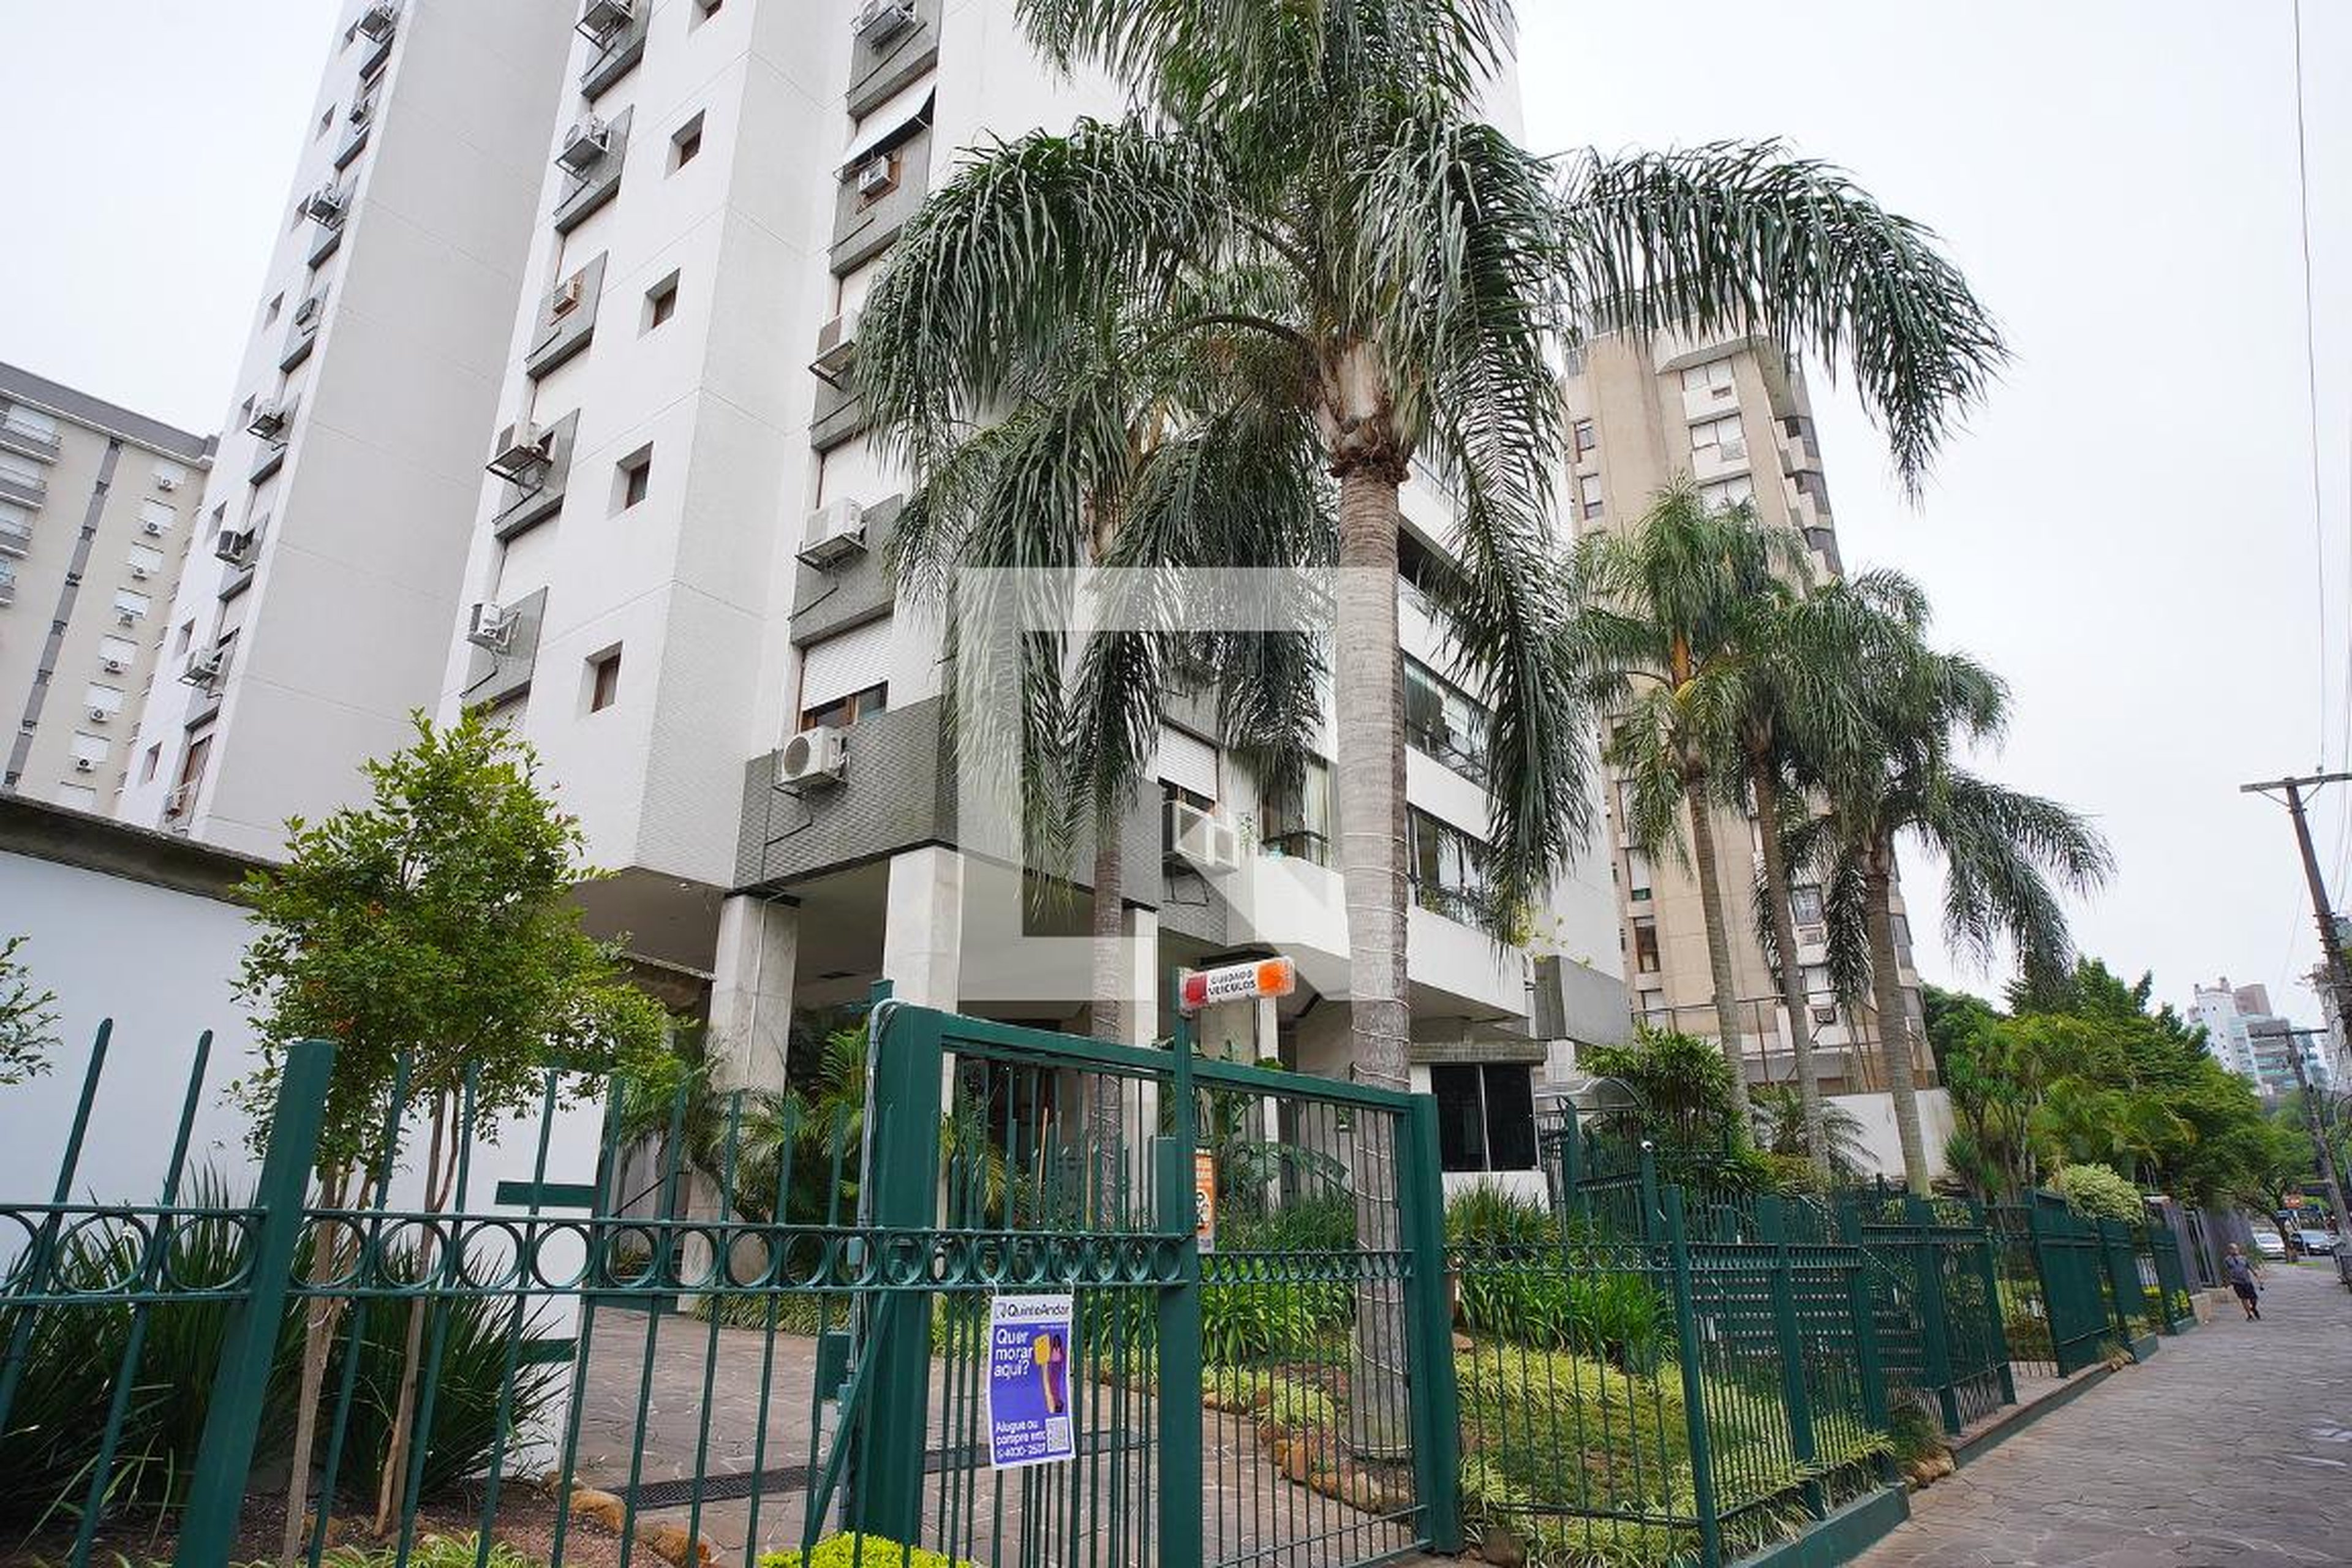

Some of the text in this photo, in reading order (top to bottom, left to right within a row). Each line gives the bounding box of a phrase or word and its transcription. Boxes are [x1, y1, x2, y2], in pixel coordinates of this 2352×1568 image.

[1008, 1303, 1069, 1317] QuintoAndar
[996, 1328, 1029, 1344] Quer
[995, 1347, 1033, 1361] morar
[993, 1360, 1030, 1379] aqui?
[995, 1420, 1026, 1434] Alugue
[996, 1432, 1030, 1446] compre
